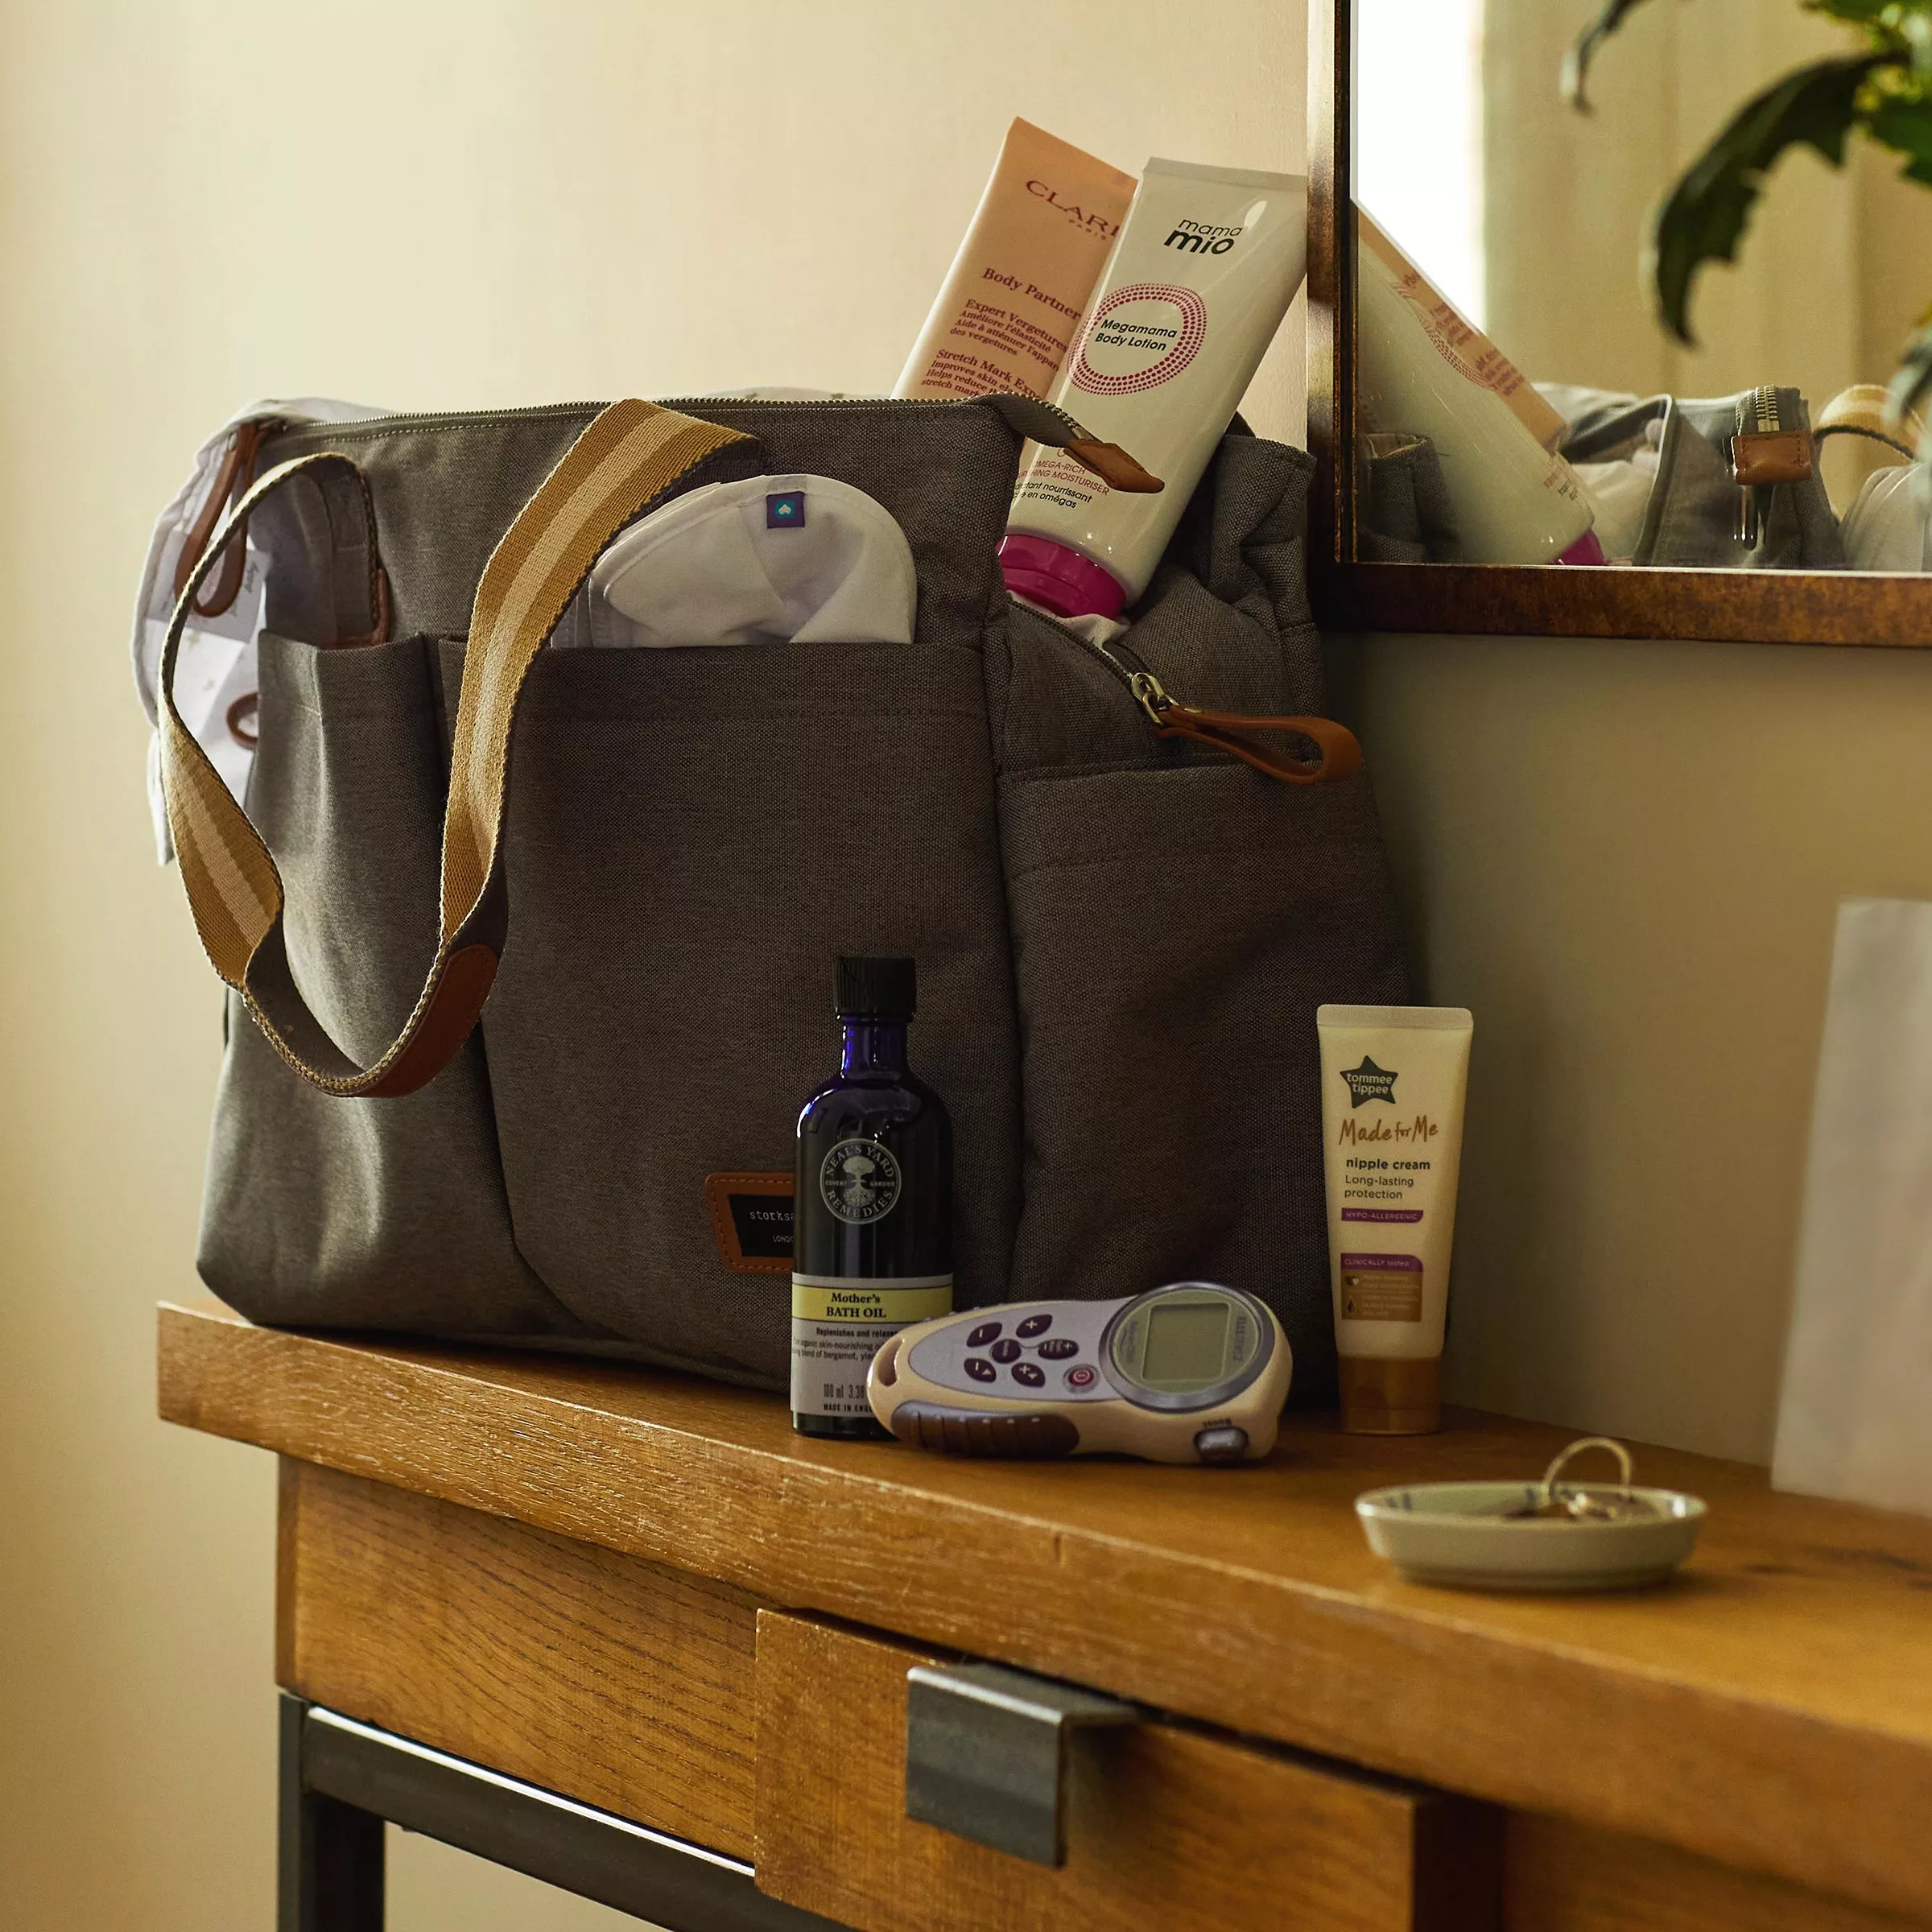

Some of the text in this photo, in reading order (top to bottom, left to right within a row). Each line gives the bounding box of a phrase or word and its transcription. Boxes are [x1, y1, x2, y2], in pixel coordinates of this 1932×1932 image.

[1179, 219, 1244, 237] mama
[1163, 229, 1235, 254] mio
[982, 267, 1082, 320] Body Partner
[959, 309, 1005, 328] Améliore
[965, 299, 1068, 353] Expert Vergetures
[955, 319, 977, 329] Aide
[986, 328, 1027, 349] atténuer
[1100, 319, 1178, 338] Megamama
[949, 327, 1018, 356] des vergetures
[1095, 332, 1166, 351] Body Lotion
[931, 360, 976, 376] Improves
[976, 373, 997, 386] skin
[936, 349, 978, 365] Stretch
[980, 360, 1013, 383] Mark
[920, 379, 953, 389] stretch
[926, 369, 953, 379] Helps
[954, 375, 988, 391] reduce
[1034, 459, 1087, 475] MEGA-RICH
[1051, 471, 1110, 496] MOISTURISER
[1039, 493, 1077, 509] omégas
[1042, 484, 1093, 503] nourrissant
[1346, 1073, 1393, 1084] tommee
[1352, 1082, 1389, 1095] tippee
[1339, 1118, 1393, 1146] Made
[1411, 1115, 1439, 1142] Me
[866, 1146, 894, 1178] YARD
[1345, 1157, 1430, 1170] nipple cream
[1345, 1174, 1414, 1187] Long-lasting
[1344, 1189, 1402, 1199] protection
[827, 1190, 893, 1218] REMEDIES
[831, 1292, 881, 1304] Mother's
[826, 1307, 887, 1319] BATH OIL
[857, 1329, 870, 1337] and
[823, 1403, 841, 1412] MADE
[844, 1404, 852, 1412] IN
